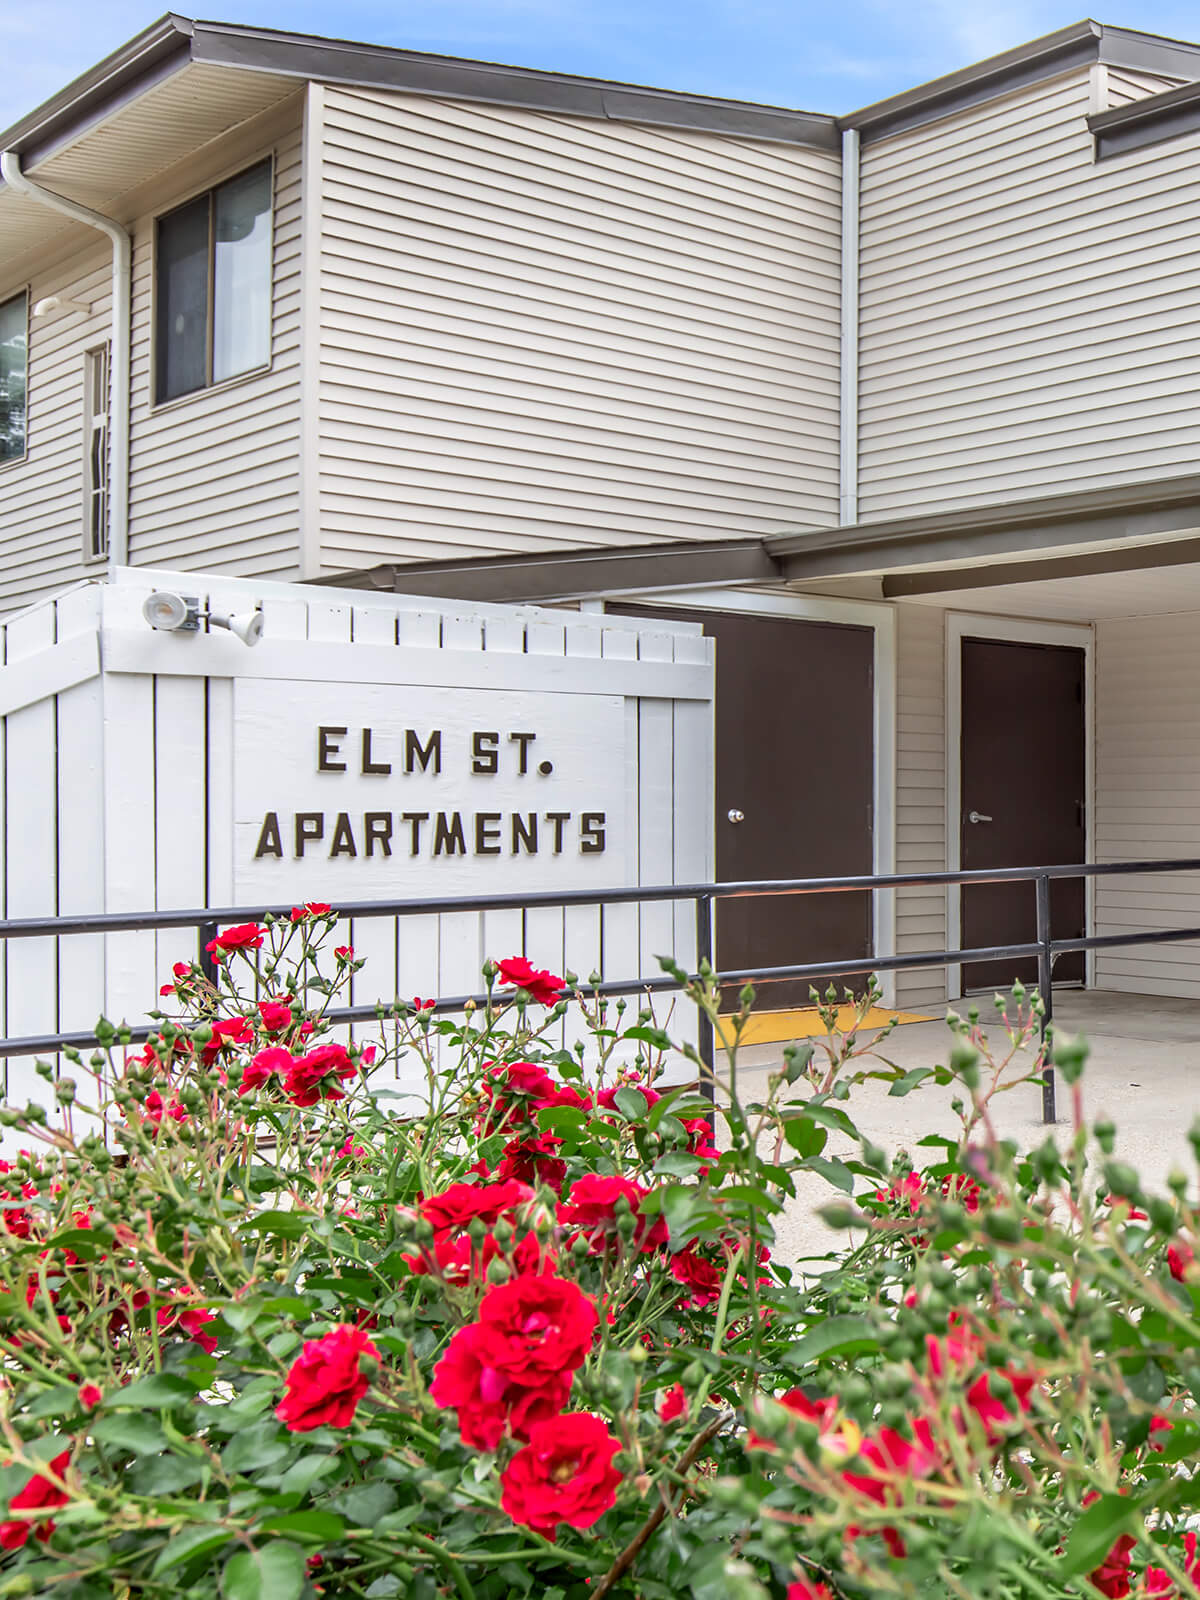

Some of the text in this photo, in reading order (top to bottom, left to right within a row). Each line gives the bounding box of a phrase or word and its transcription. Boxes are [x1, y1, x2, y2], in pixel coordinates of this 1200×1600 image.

[317, 726, 554, 777] ELM ST.
[253, 811, 607, 860] APARTMENTS
